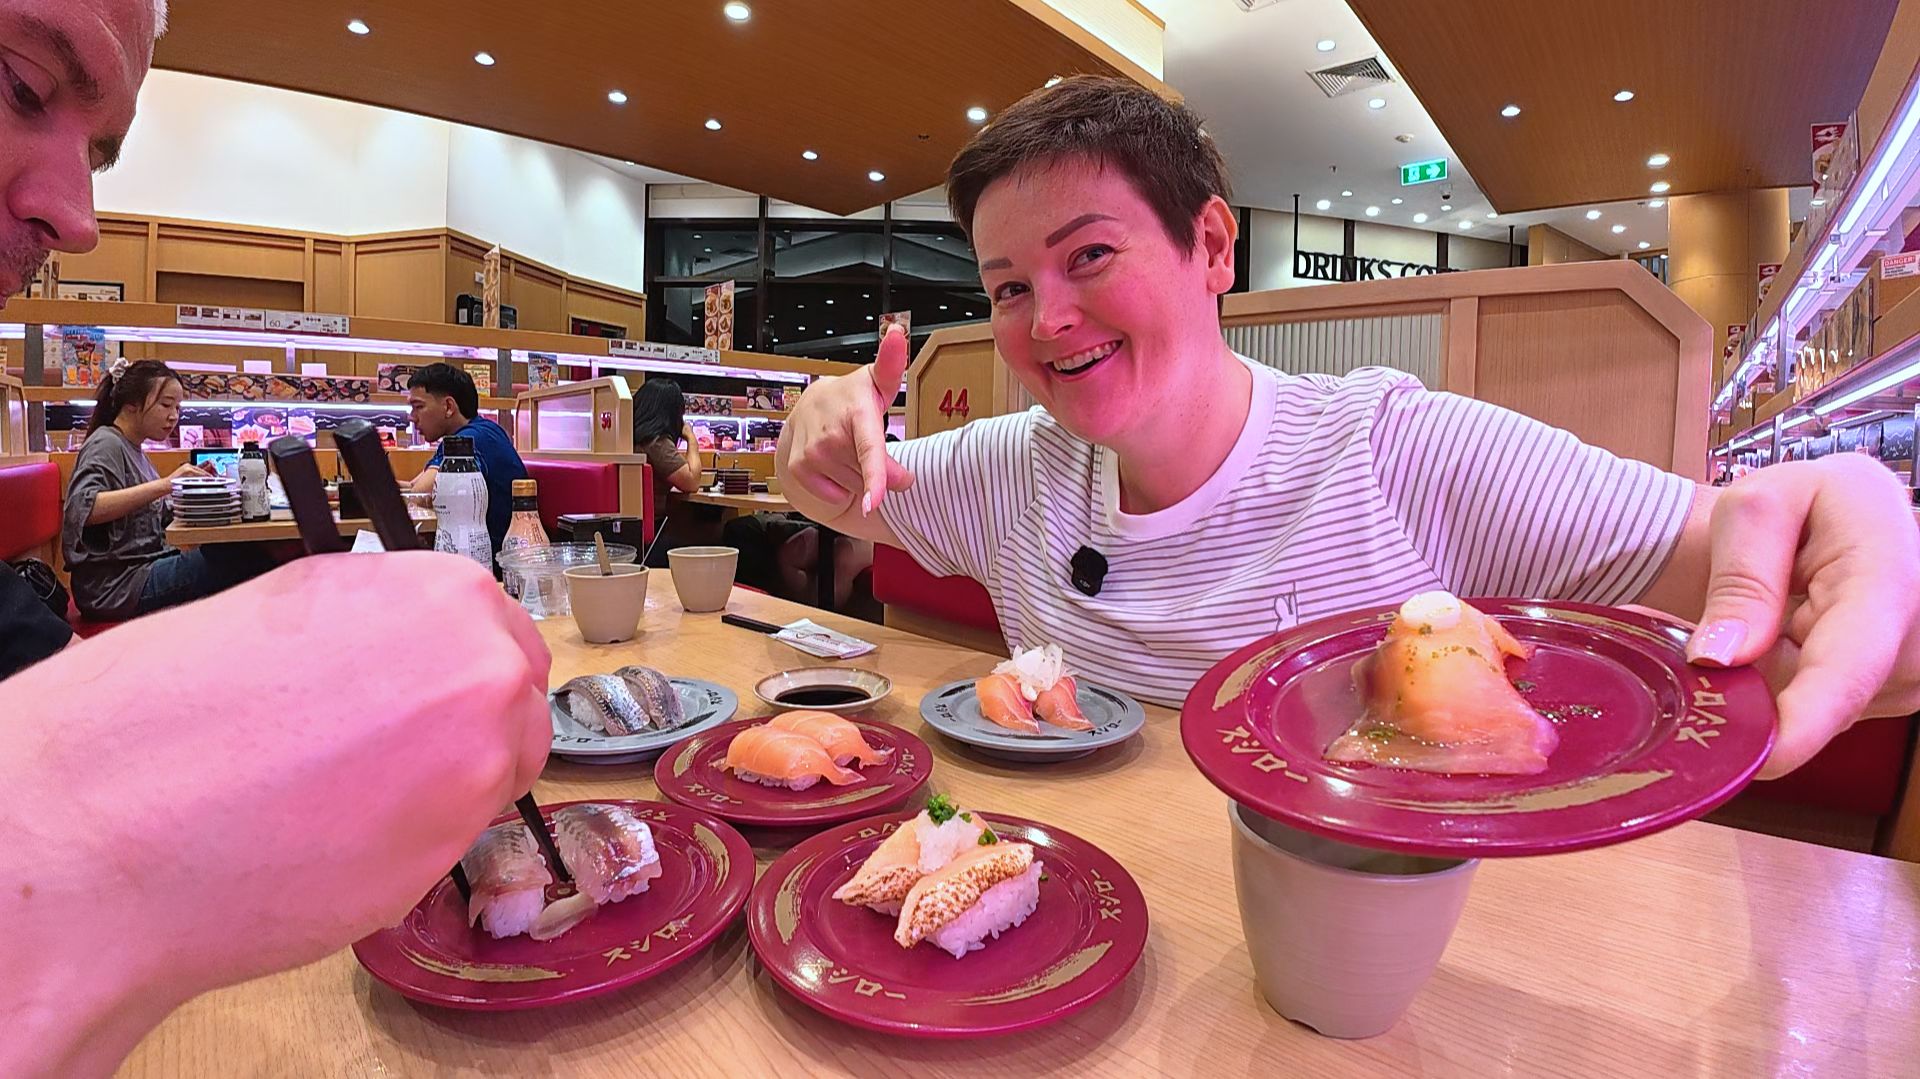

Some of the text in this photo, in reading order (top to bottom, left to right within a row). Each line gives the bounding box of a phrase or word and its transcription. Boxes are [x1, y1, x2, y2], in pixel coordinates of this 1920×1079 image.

[1295, 251, 1392, 281] DRINKS
[939, 388, 970, 418] 44
[1674, 676, 1727, 749] スシロー
[1216, 725, 1308, 783] スシロー
[683, 783, 743, 804] スシロー
[842, 821, 904, 842] シロー
[1089, 868, 1122, 923] スシロー
